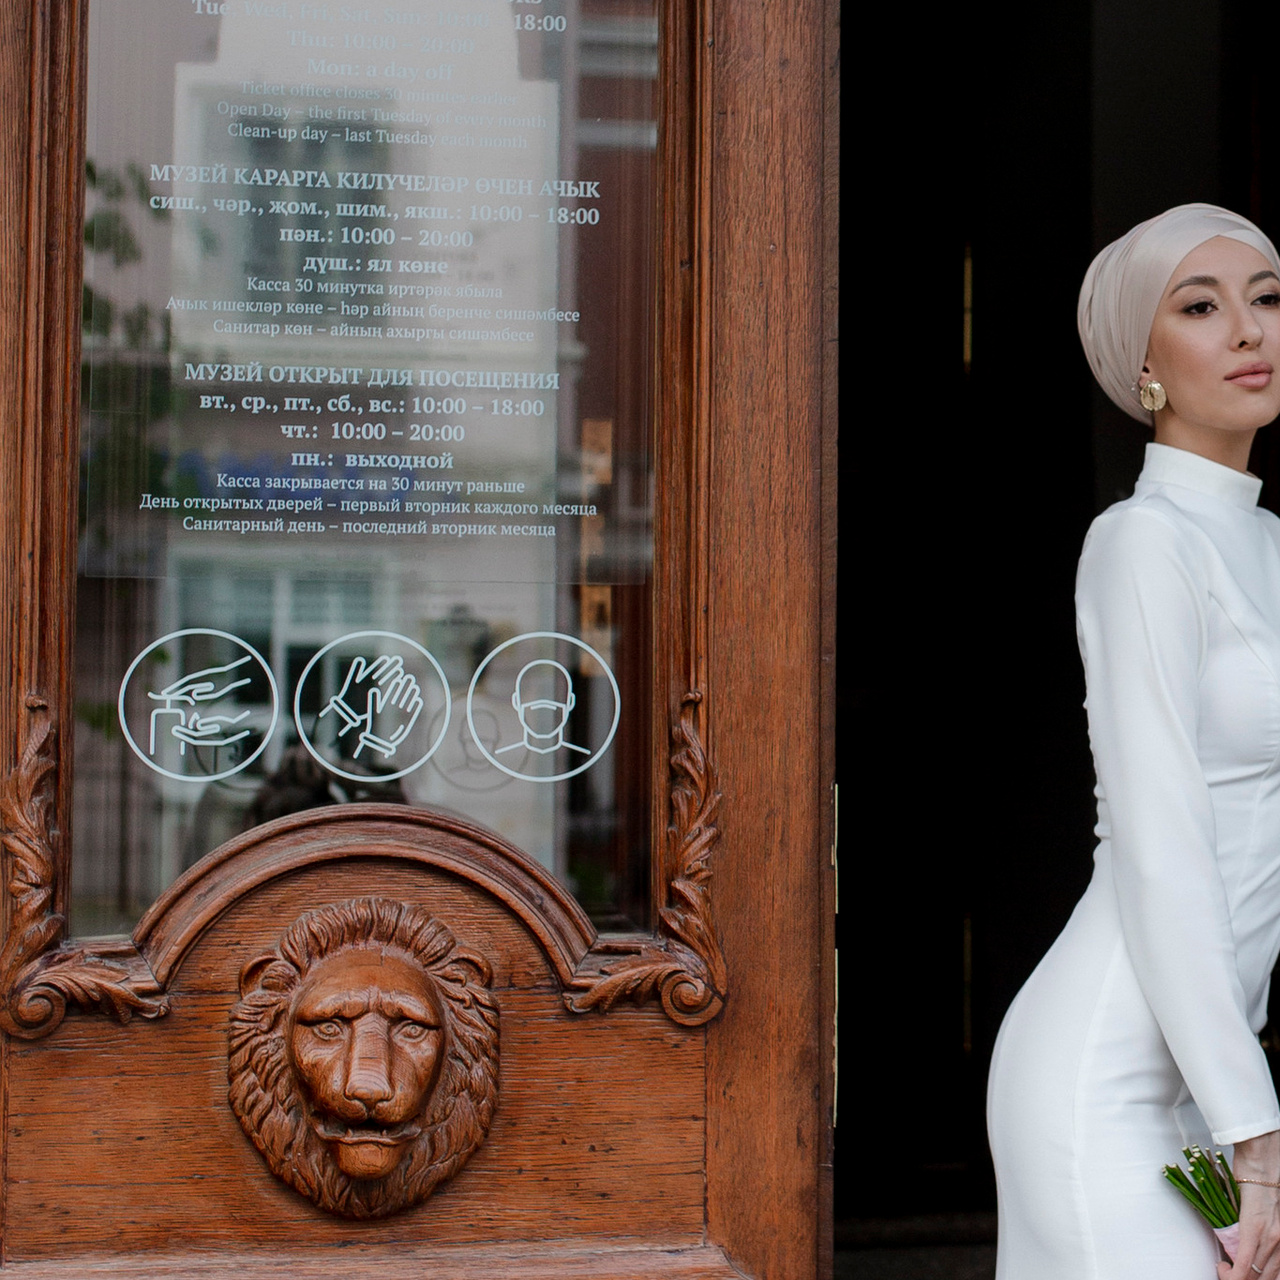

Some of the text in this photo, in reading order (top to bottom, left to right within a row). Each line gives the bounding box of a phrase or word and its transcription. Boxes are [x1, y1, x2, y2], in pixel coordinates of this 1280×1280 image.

[286, 29, 334, 49] Thu:
[344, 31, 398, 51] 10:00
[419, 35, 475, 55] 20:00
[307, 58, 454, 83] Mon: a day off
[240, 81, 517, 106] Ticket office closes 30 minutes earlier
[217, 101, 258, 118] Open
[262, 104, 291, 120] Day
[308, 105, 332, 119] the
[337, 106, 366, 121] first
[371, 108, 430, 126] Tuesday
[435, 111, 452, 124] of
[454, 114, 494, 129] every
[498, 114, 548, 128] month
[227, 123, 297, 143] Clean-up
[301, 127, 328, 144] day
[345, 129, 372, 142] last
[375, 130, 437, 148] Tuesday
[440, 133, 475, 146] each
[479, 136, 528, 150] month
[150, 164, 228, 184] МУЗЕЙ
[233, 168, 331, 189] КАРАРГА
[475, 178, 535, 195] ӨЧЕН
[540, 180, 600, 198] АЧЫК
[150, 195, 207, 213] сиш.,
[213, 198, 264, 217] чәр.,
[336, 203, 399, 221] шим.,
[404, 206, 463, 220] якш.:
[469, 204, 523, 222] 10:00
[547, 207, 600, 225] 18:00
[280, 227, 333, 244] пән.:
[340, 227, 395, 246] 10:00
[418, 230, 474, 248] 20:00
[367, 259, 392, 272] ял
[398, 260, 448, 274] көне
[247, 277, 503, 300] Касса 30 минутка иртәрәк ябыла
[165, 296, 208, 311] Ачык
[212, 300, 282, 315] ишекләр
[286, 303, 323, 314] көне
[373, 303, 424, 318] айның
[428, 304, 491, 321] беренче
[495, 307, 580, 322] сишәмбесе
[213, 320, 280, 337] Санитар
[284, 324, 313, 335] көн
[330, 323, 382, 339] айның
[386, 326, 445, 341] ахыргы
[449, 326, 534, 342] сишәмбесе
[185, 361, 560, 390] МУЗЕЙ ОТКРЫТ ДЛЯ ПОСЕЩЕНИЯ
[200, 395, 236, 412] вт.,
[241, 396, 278, 413] ср.,
[284, 398, 321, 414] пт.,
[327, 394, 363, 415] сб.,
[369, 400, 405, 413] вс.:
[412, 397, 467, 414] 10:00
[491, 399, 545, 417] 18:00
[280, 425, 318, 438] чт.:
[331, 422, 386, 440] 10:00
[409, 424, 465, 441] 20:00
[291, 452, 454, 471] пн.: выходной
[216, 473, 525, 495] Касса закрывается на 30 минут раньше
[140, 493, 179, 510] День
[183, 497, 263, 512] открытых
[266, 497, 323, 514] дверей
[341, 499, 400, 515] первый
[404, 503, 469, 517] вторник
[474, 503, 538, 518] каждого
[542, 505, 597, 517] месяца
[183, 516, 284, 533] Санитарный
[287, 521, 325, 534] день
[342, 520, 427, 537] последний
[431, 523, 496, 538] вторник
[501, 525, 556, 537] месяца
